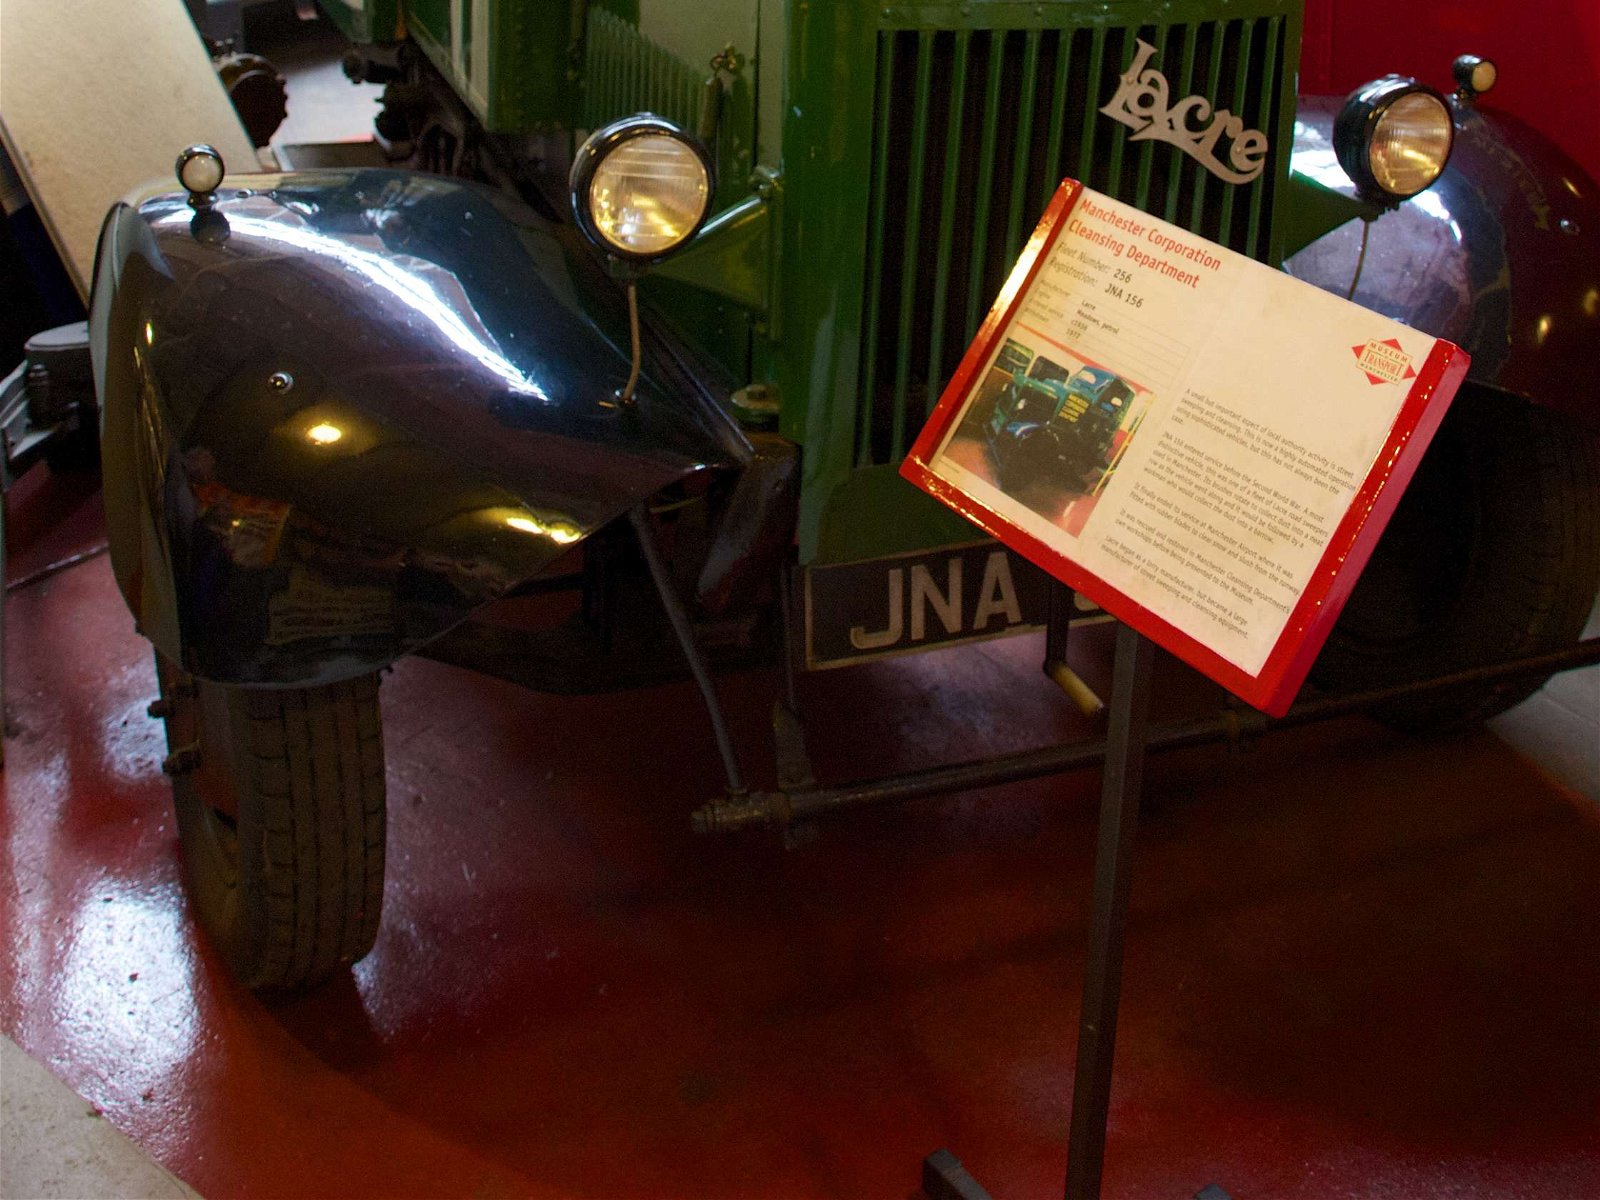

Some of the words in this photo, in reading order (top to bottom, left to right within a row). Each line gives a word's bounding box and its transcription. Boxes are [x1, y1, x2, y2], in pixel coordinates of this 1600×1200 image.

[1099, 37, 1268, 185] Lacre
[1078, 198, 1148, 237] Manchester
[1144, 227, 1224, 274] Corporation
[1065, 218, 1126, 257] Cleansing
[1123, 244, 1202, 291] Department
[1112, 267, 1133, 283] 256
[1081, 299, 1096, 310] Lacre
[1104, 282, 1124, 299] JNA
[1124, 292, 1144, 308] 156
[1362, 348, 1404, 376] TRANSPORT
[1369, 342, 1408, 362] MUSEUM
[850, 551, 1002, 650] JNA
